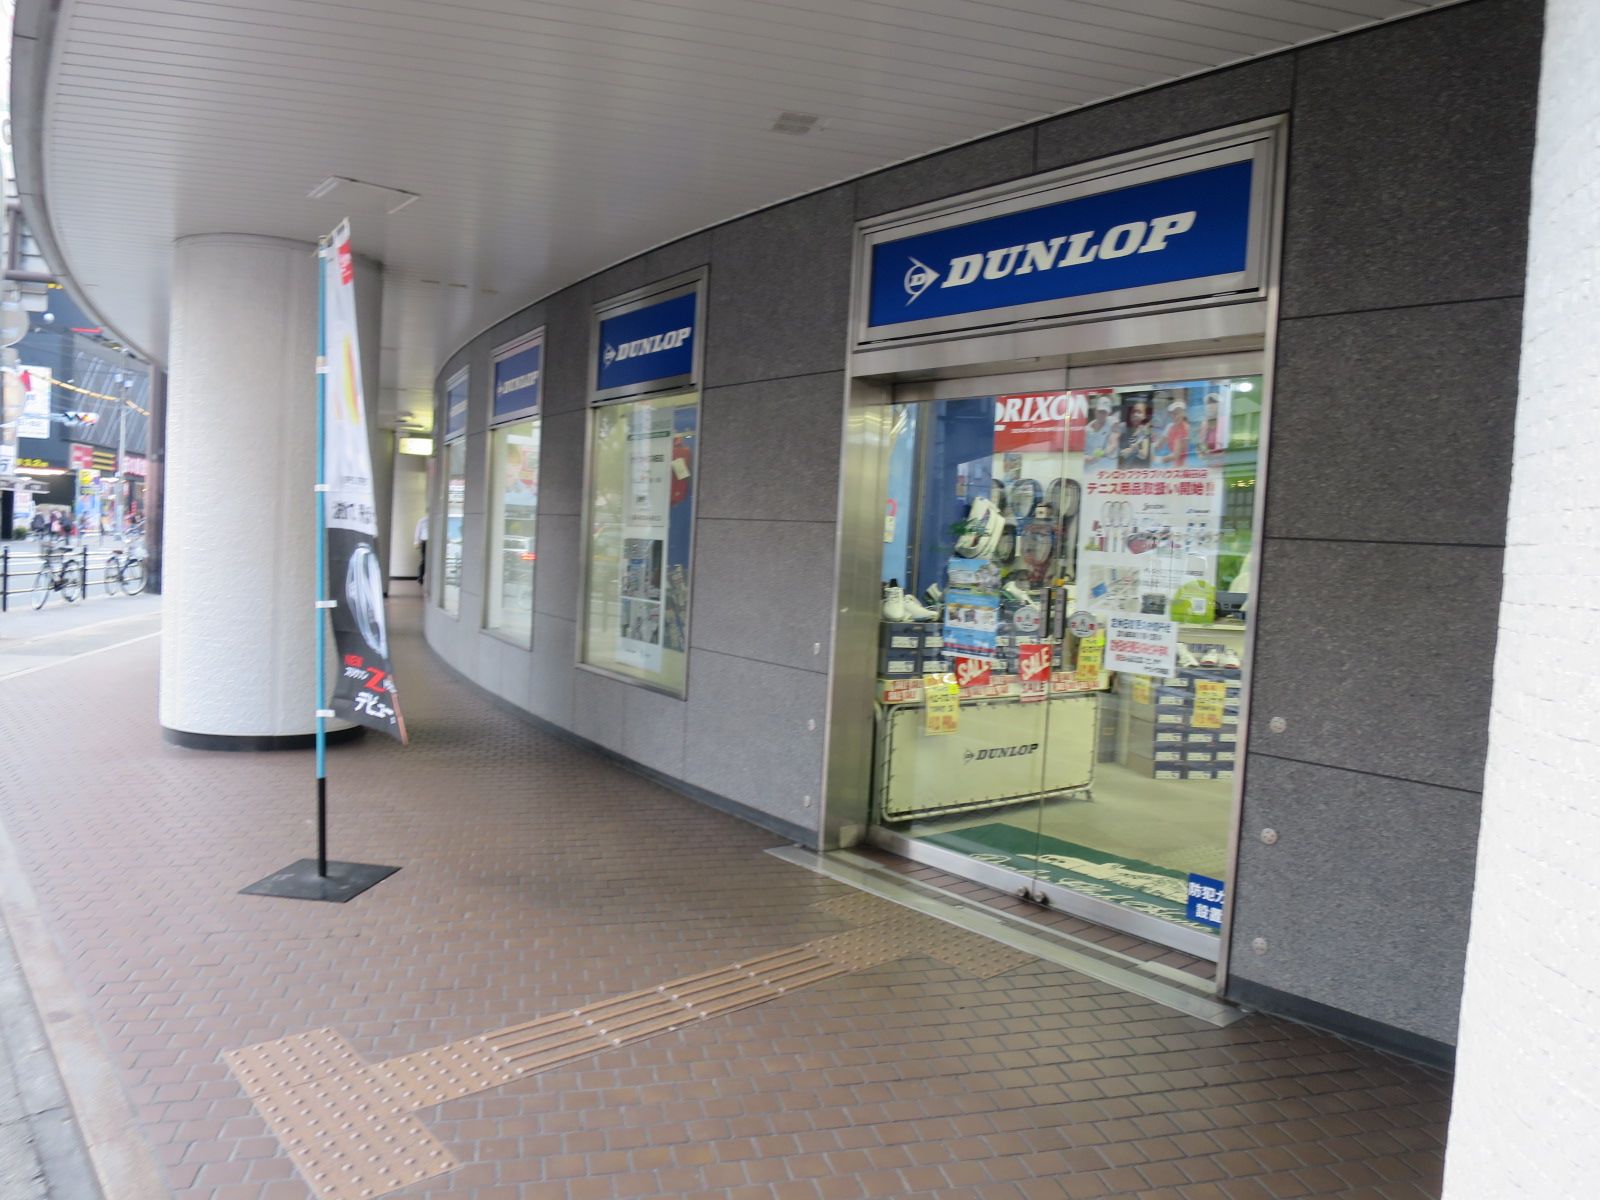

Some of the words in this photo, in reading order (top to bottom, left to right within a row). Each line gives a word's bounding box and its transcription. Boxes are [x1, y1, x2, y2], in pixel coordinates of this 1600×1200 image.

[941, 211, 1197, 288] DUNLOP
[615, 327, 692, 361] DUNLOP
[1021, 647, 1051, 681] SALE
[976, 743, 1038, 761] DUNLOP
